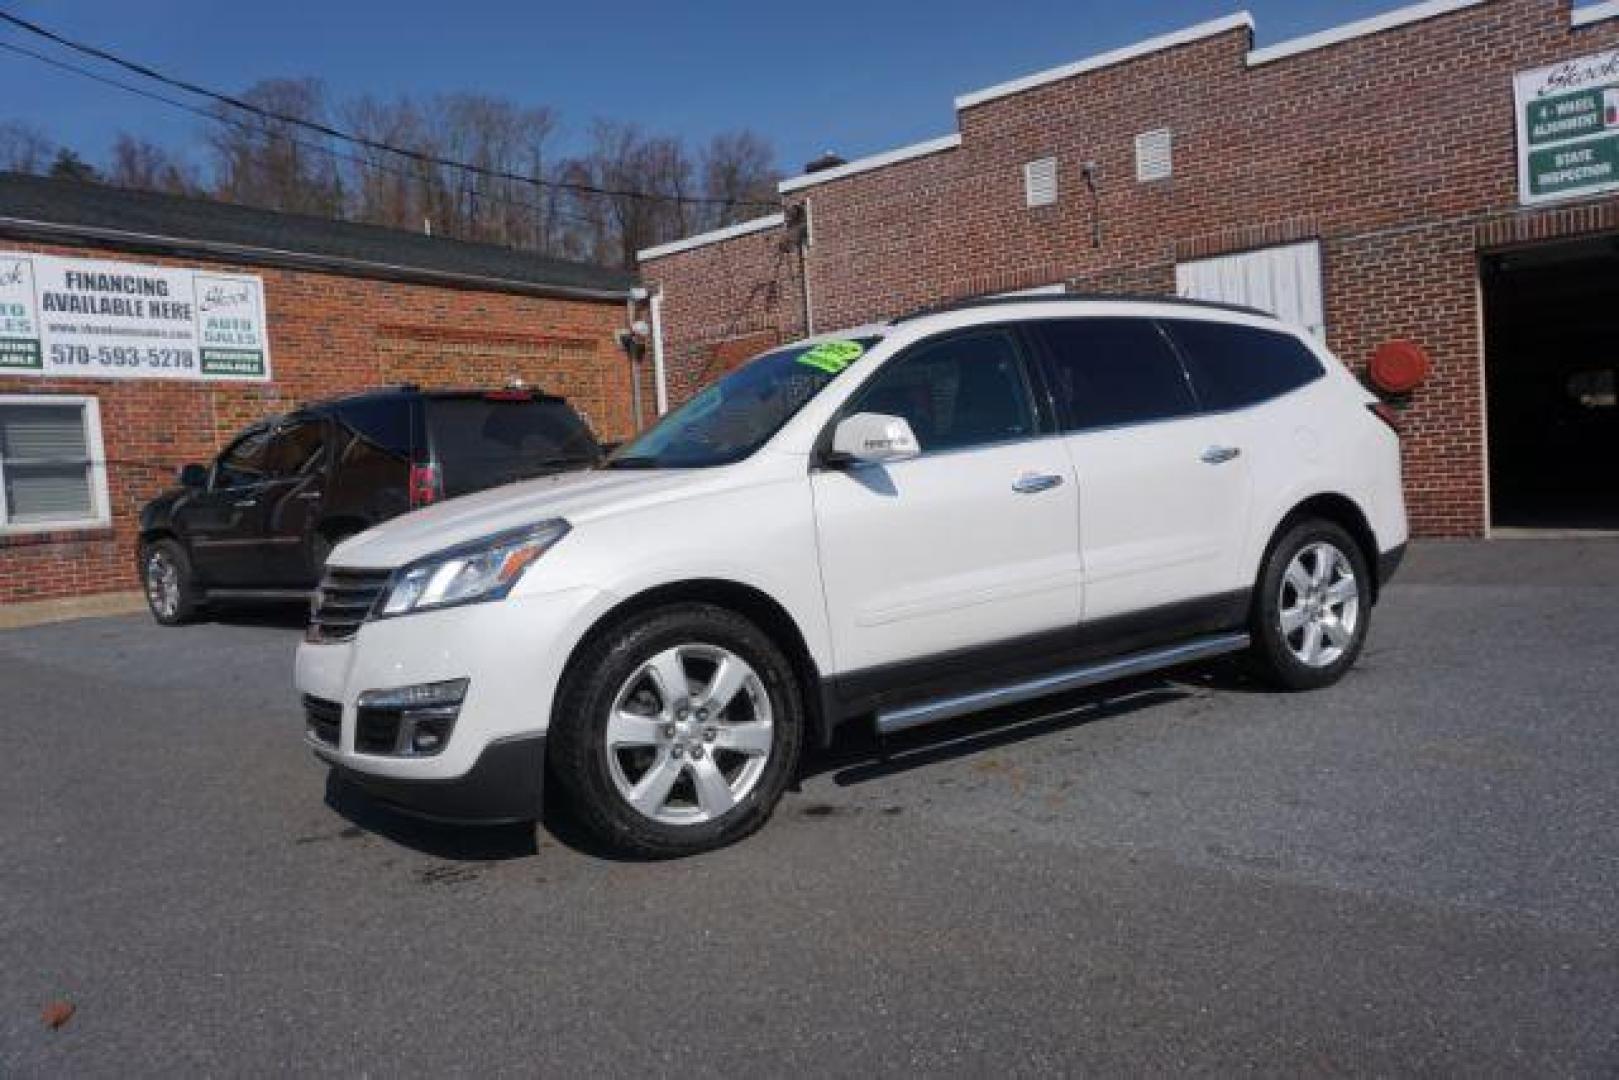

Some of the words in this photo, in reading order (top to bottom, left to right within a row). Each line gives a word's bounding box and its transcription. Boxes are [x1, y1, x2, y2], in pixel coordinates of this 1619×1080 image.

[1555, 149, 1594, 168] STATE
[65, 271, 169, 296] FINANCING
[42, 293, 143, 317] AVAILABLE
[149, 301, 193, 321] HERE
[50, 343, 193, 368] 570-593-5278
